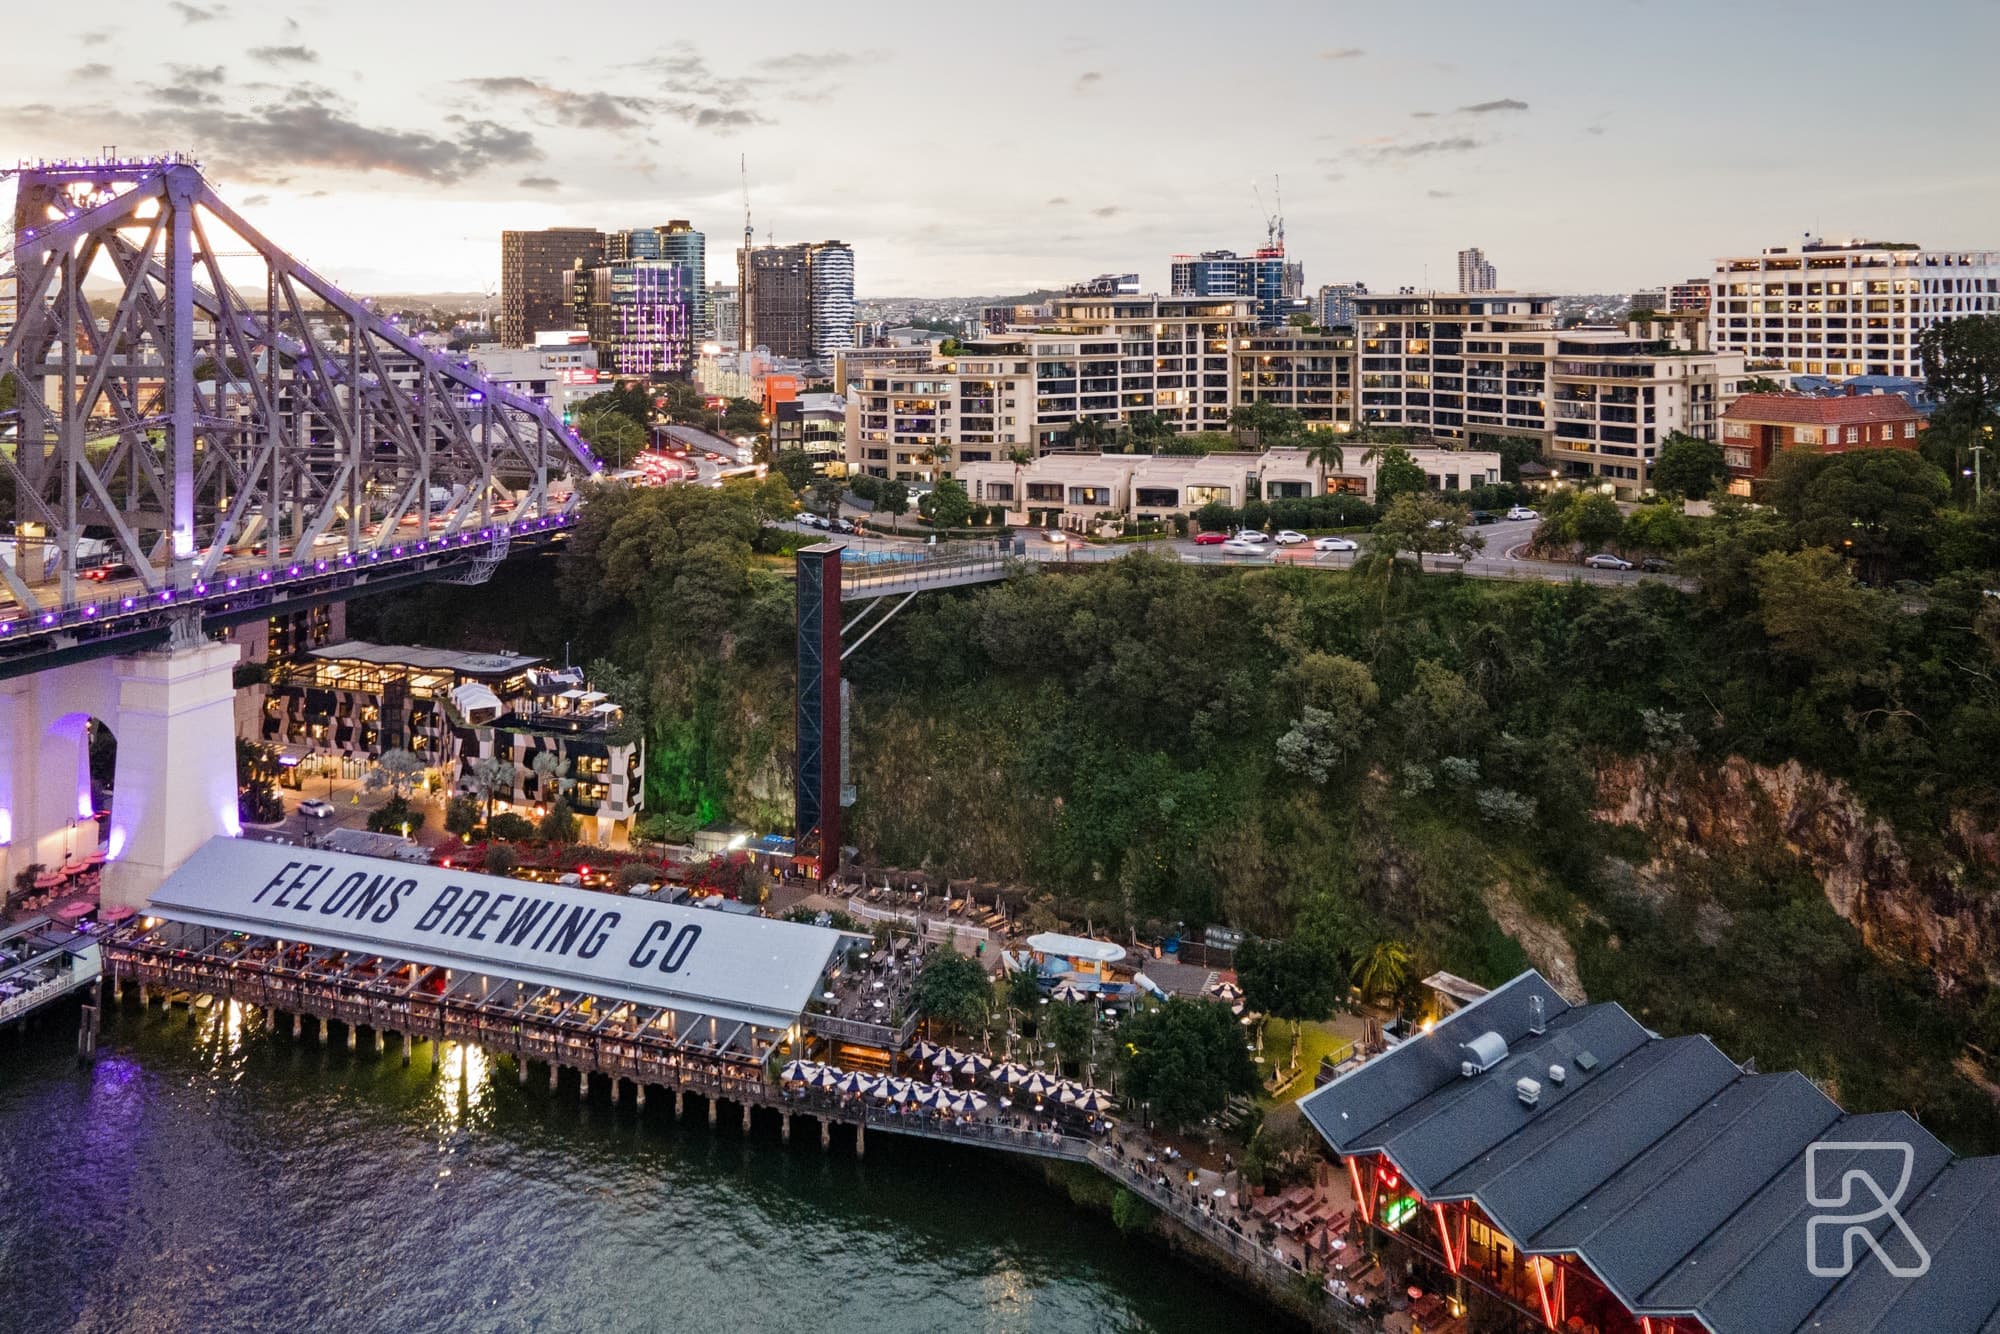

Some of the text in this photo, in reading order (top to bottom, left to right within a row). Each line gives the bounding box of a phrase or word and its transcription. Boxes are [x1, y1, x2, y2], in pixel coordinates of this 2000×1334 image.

[252, 861, 702, 977] FELONS BREWING CO.
